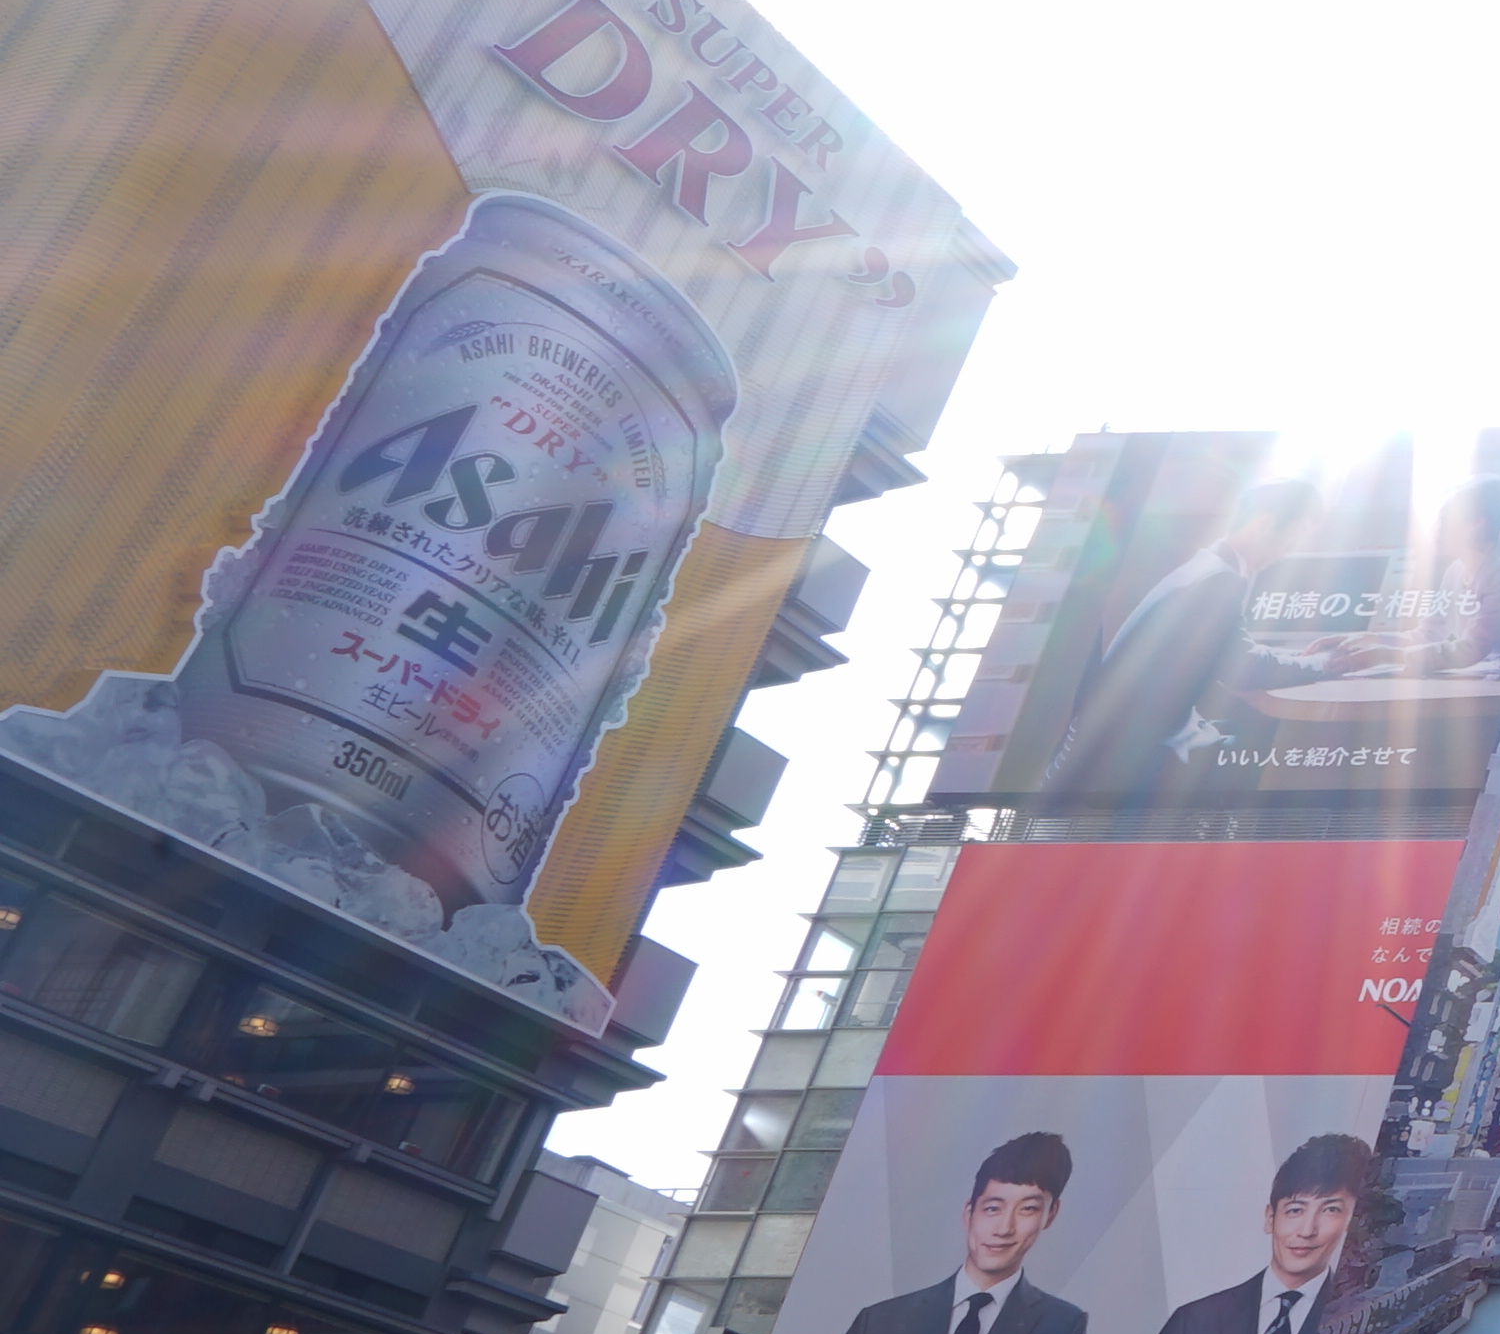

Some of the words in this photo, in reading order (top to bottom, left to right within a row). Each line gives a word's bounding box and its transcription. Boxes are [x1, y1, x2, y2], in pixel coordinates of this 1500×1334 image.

[459, 333, 514, 364] ASAHI
[528, 335, 623, 408] BREWERIES
[618, 413, 650, 489] LIMITED
[531, 402, 581, 440] SUPER
[337, 403, 648, 647] Asahi
[397, 589, 494, 677] 生
[1251, 588, 1482, 621] 相続のご相談も
[330, 631, 500, 740] スーパードライ
[333, 740, 415, 802] 350ml
[1217, 746, 1417, 768] いい人を紹介させて
